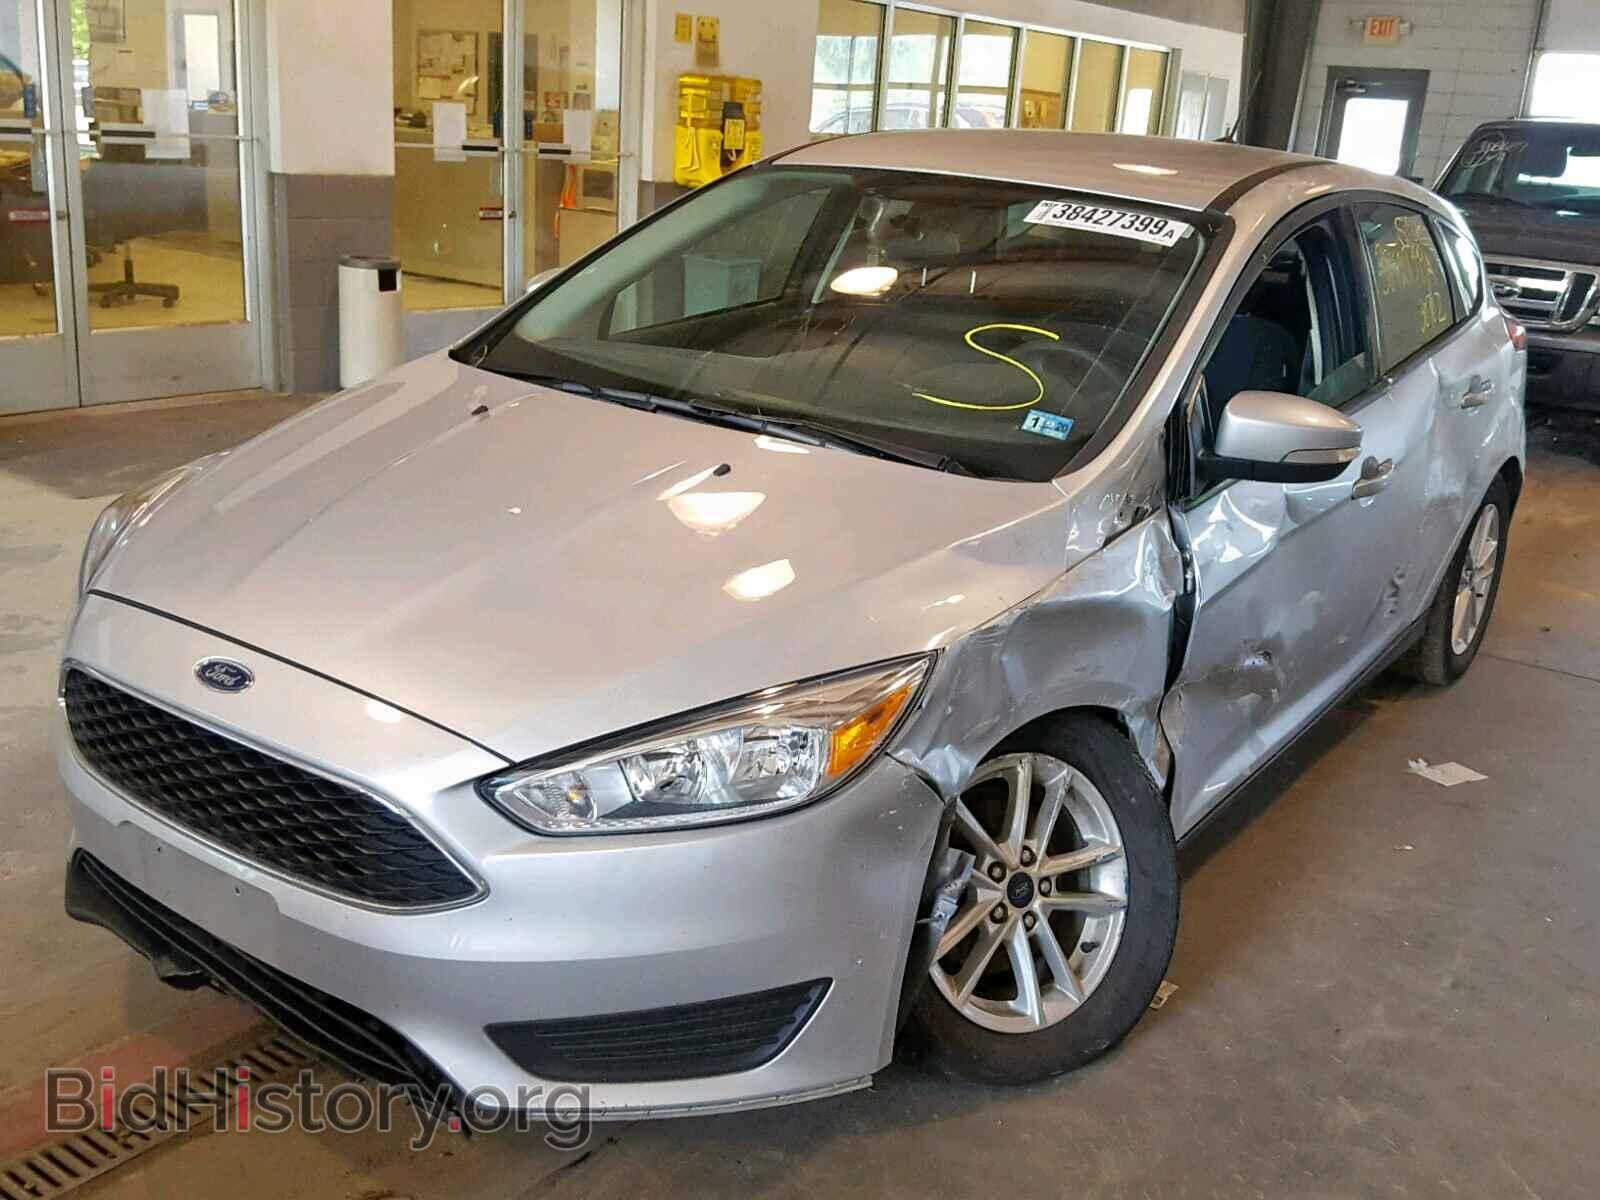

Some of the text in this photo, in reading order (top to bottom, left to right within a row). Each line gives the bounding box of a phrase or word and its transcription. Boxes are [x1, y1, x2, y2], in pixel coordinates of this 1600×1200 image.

[1369, 19, 1396, 36] EXIT
[1031, 416, 1041, 428] 1
[1054, 422, 1069, 433] 20
[204, 664, 242, 686] Ford
